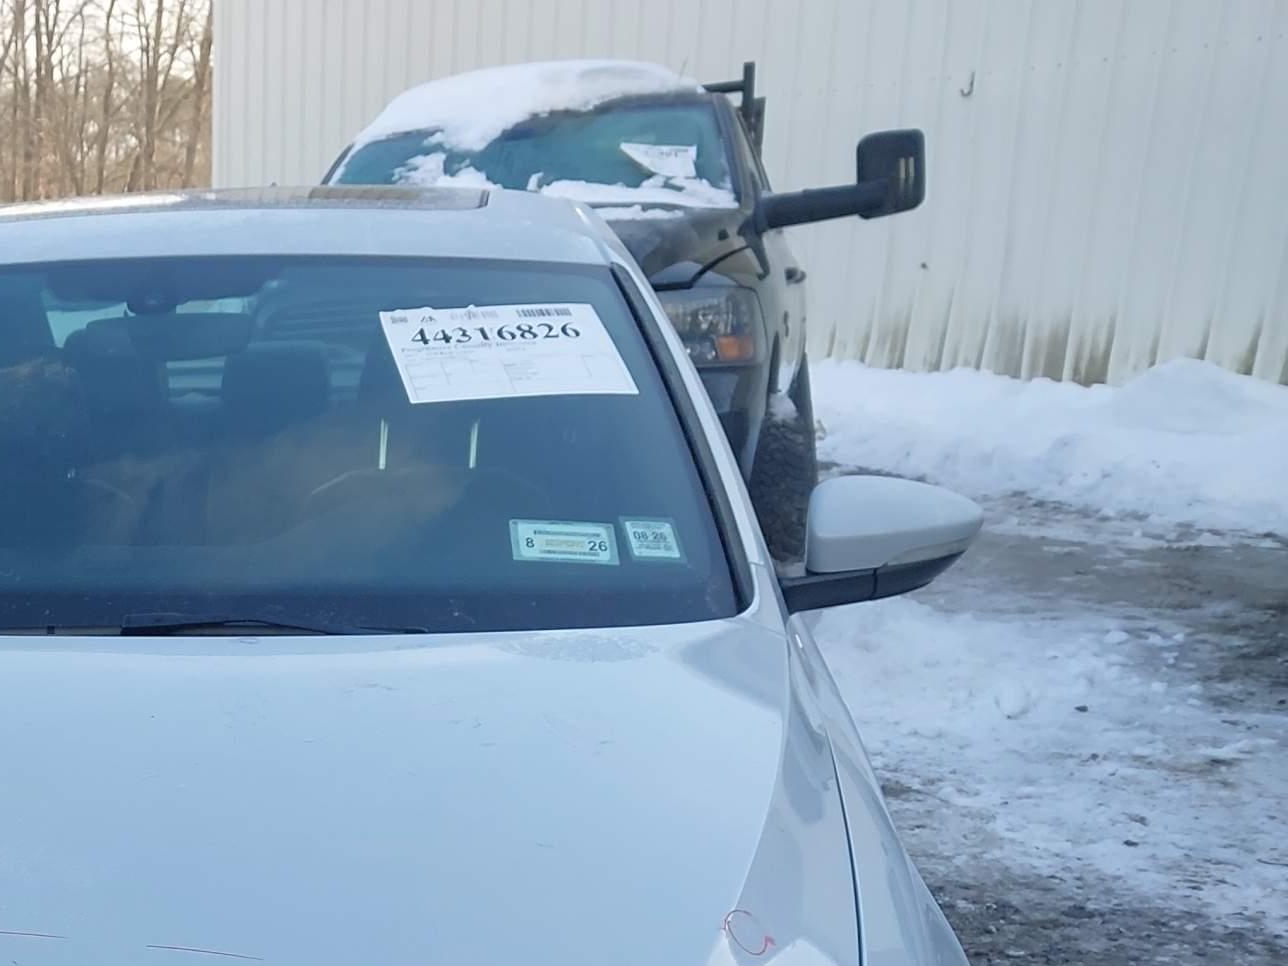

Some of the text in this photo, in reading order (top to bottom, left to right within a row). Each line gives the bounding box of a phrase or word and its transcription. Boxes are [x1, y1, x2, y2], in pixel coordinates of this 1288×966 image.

[410, 321, 581, 346] 44316826
[525, 537, 535, 548] 8
[587, 540, 608, 552] 26
